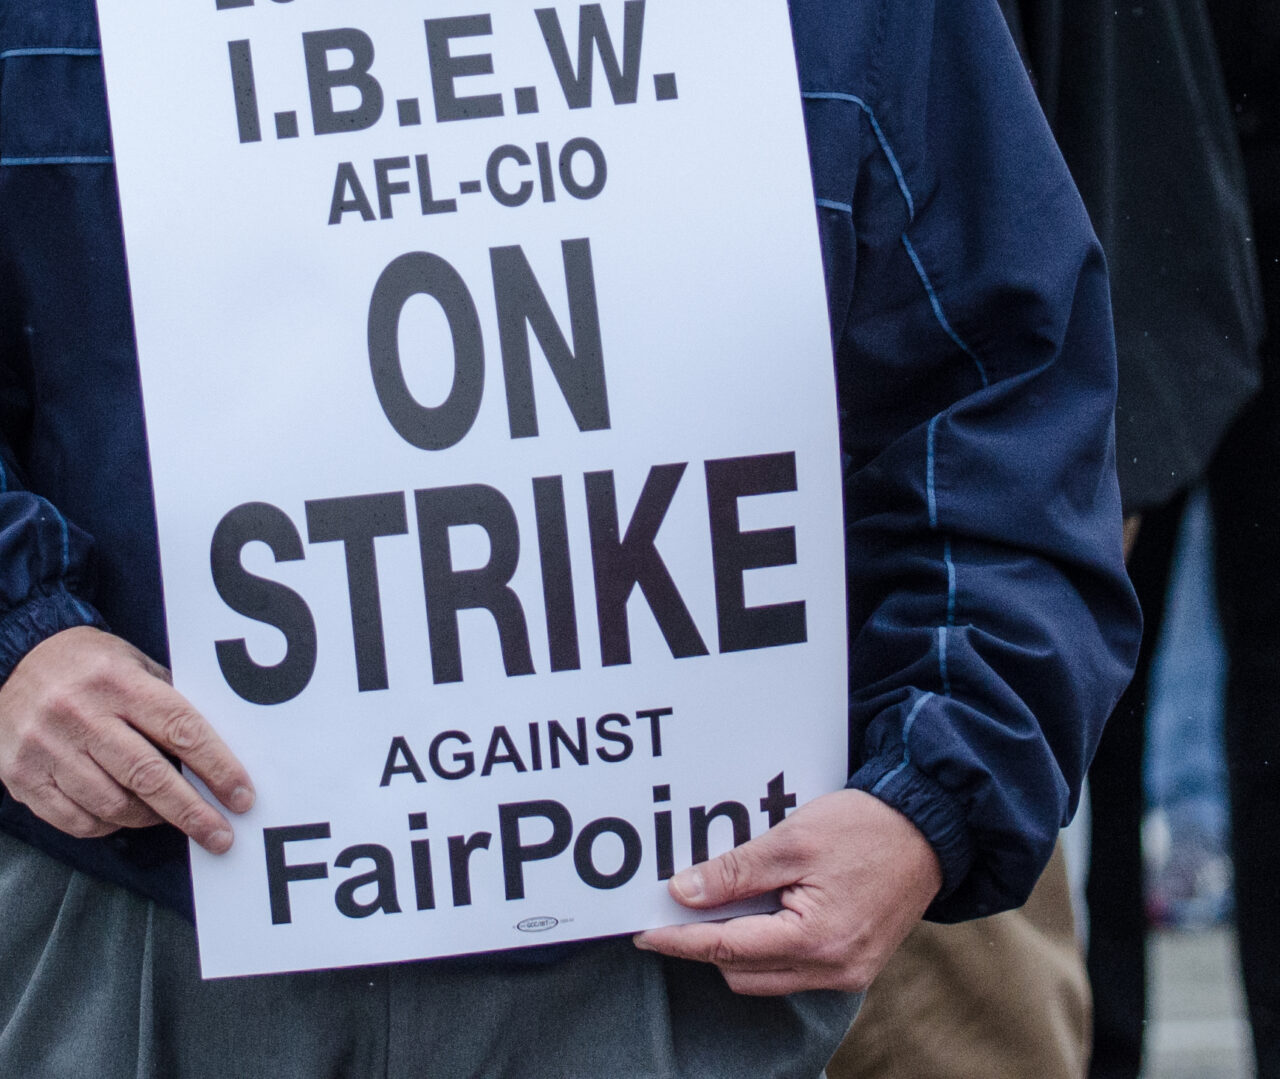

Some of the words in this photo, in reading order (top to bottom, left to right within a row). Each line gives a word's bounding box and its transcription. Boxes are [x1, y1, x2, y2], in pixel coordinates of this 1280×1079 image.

[327, 136, 609, 225] AFL-CIO
[366, 236, 612, 452] ON
[208, 450, 809, 707] STRIKE
[378, 706, 674, 788] AGAINST
[261, 770, 797, 925] FairPoint
